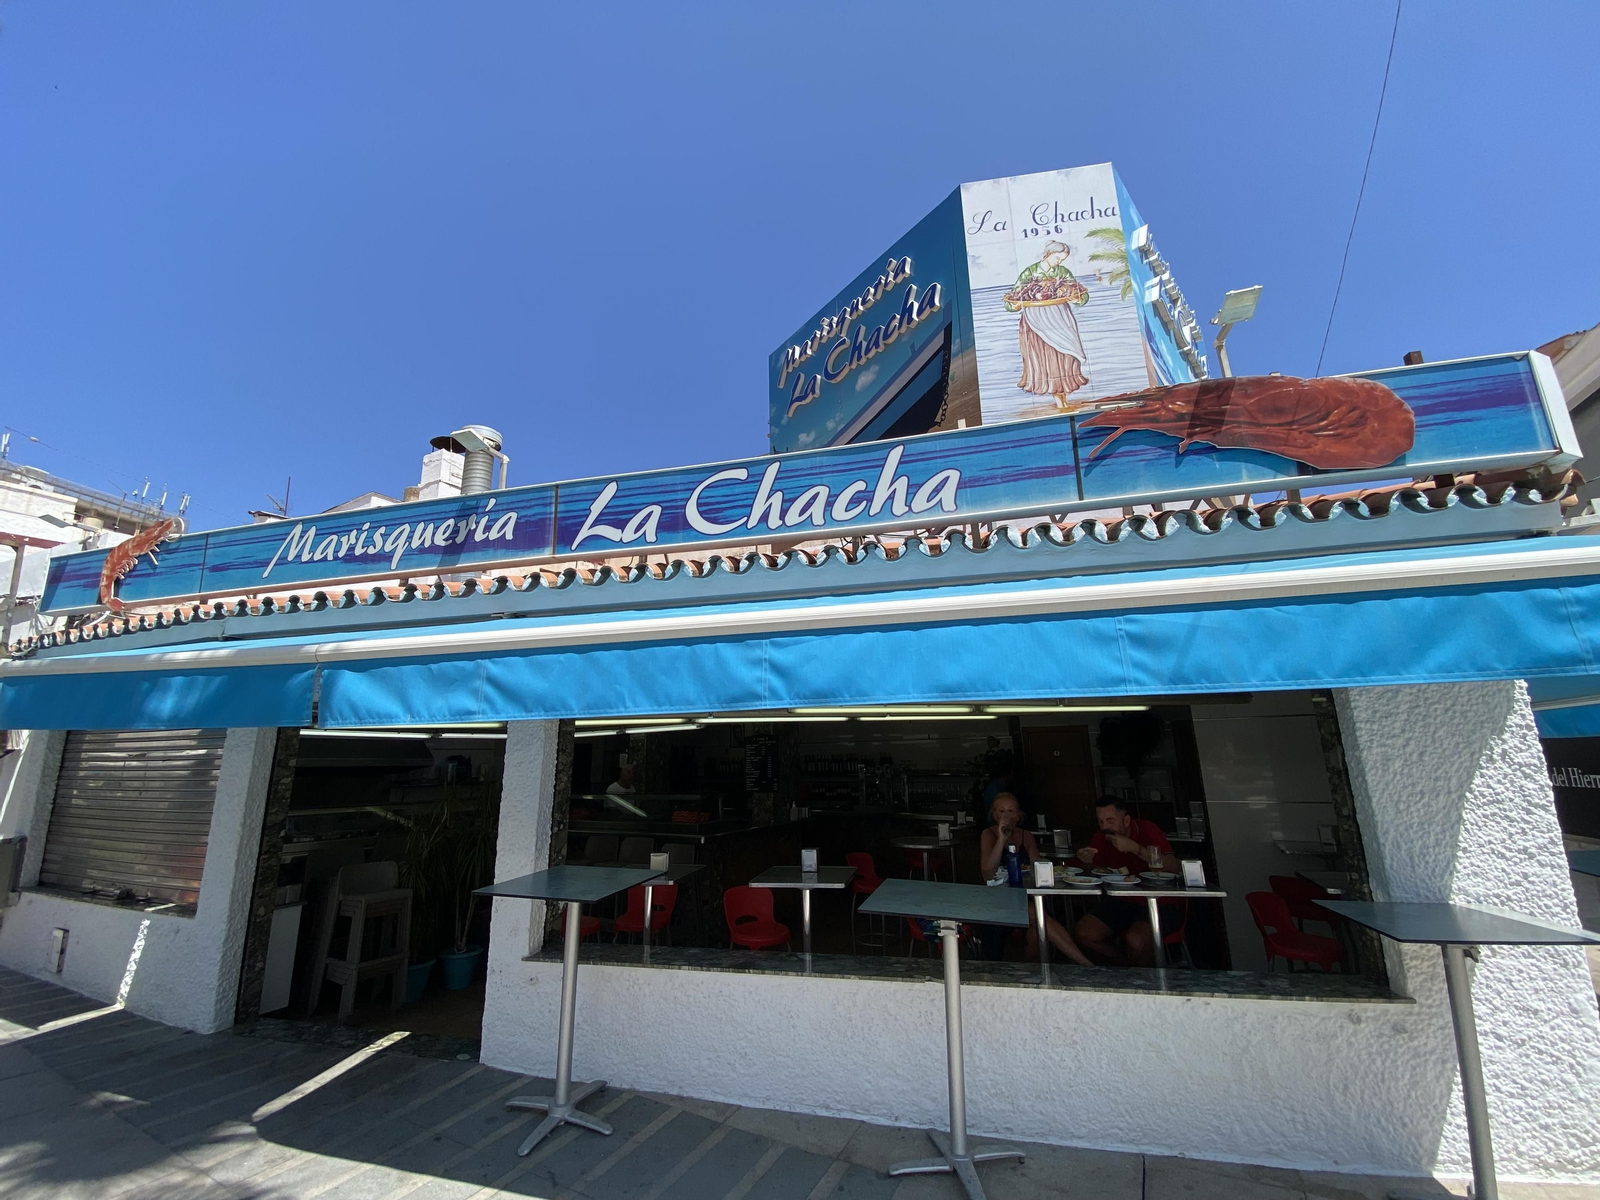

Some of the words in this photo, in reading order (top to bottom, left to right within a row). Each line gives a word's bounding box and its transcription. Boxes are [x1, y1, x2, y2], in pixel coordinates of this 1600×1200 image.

[967, 210, 1008, 235] La
[1029, 196, 1119, 226] Chacha
[1021, 224, 1063, 239] 1956
[777, 255, 912, 389] Marisquería
[786, 371, 822, 418] La
[823, 281, 942, 384] Chacha
[261, 497, 519, 579] Marisquería
[570, 479, 663, 552] La
[684, 443, 962, 536] Chacha
[1551, 767, 1569, 787] del
